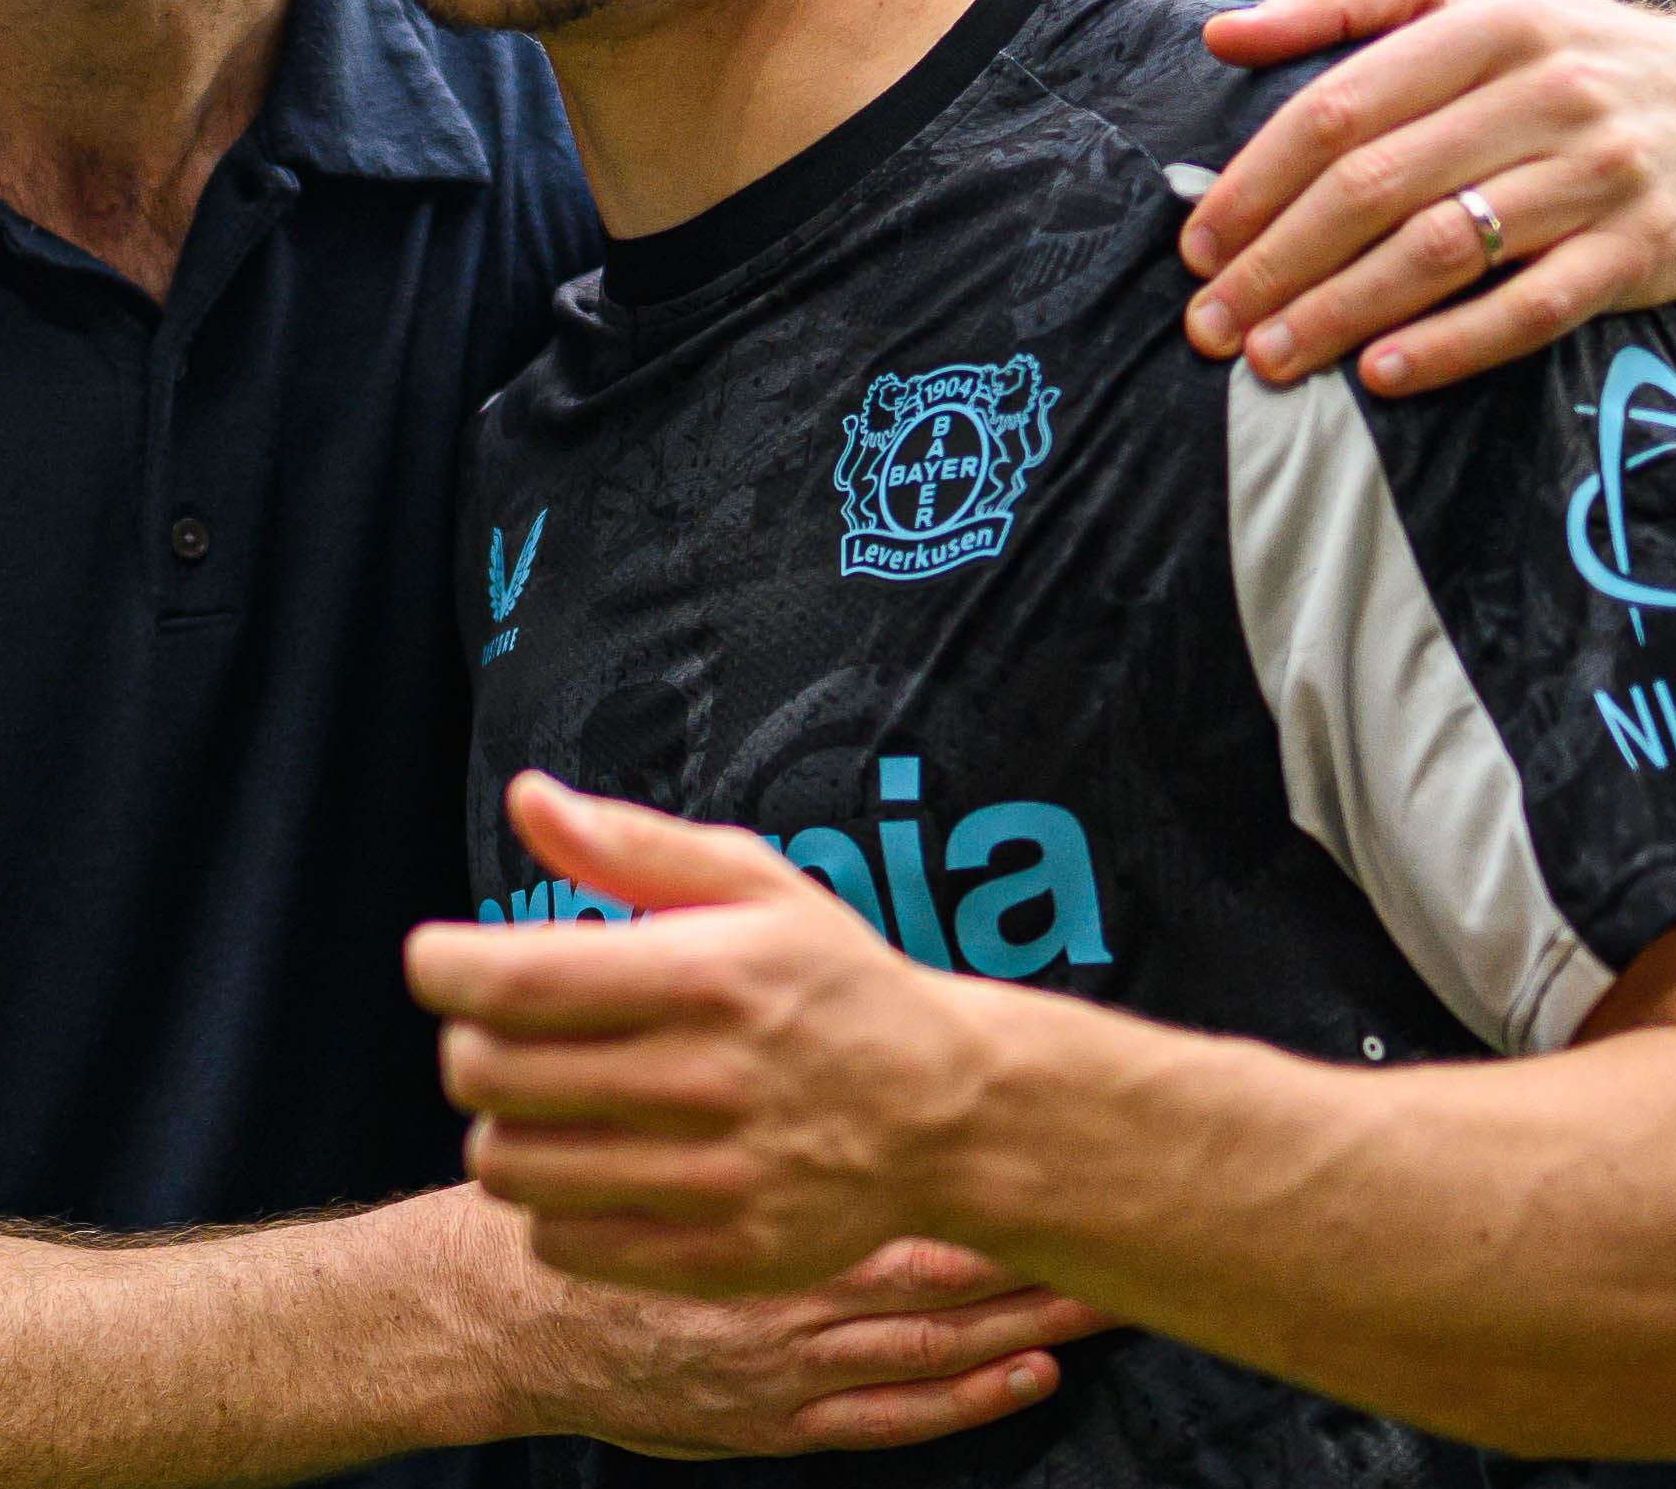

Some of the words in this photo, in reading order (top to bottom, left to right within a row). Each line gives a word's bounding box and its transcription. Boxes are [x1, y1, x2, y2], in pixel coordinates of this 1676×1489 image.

[924, 377, 974, 403] 1904
[889, 456, 979, 487] BAYER
[915, 415, 951, 529] BAYER
[852, 527, 993, 571] Leverkusen
